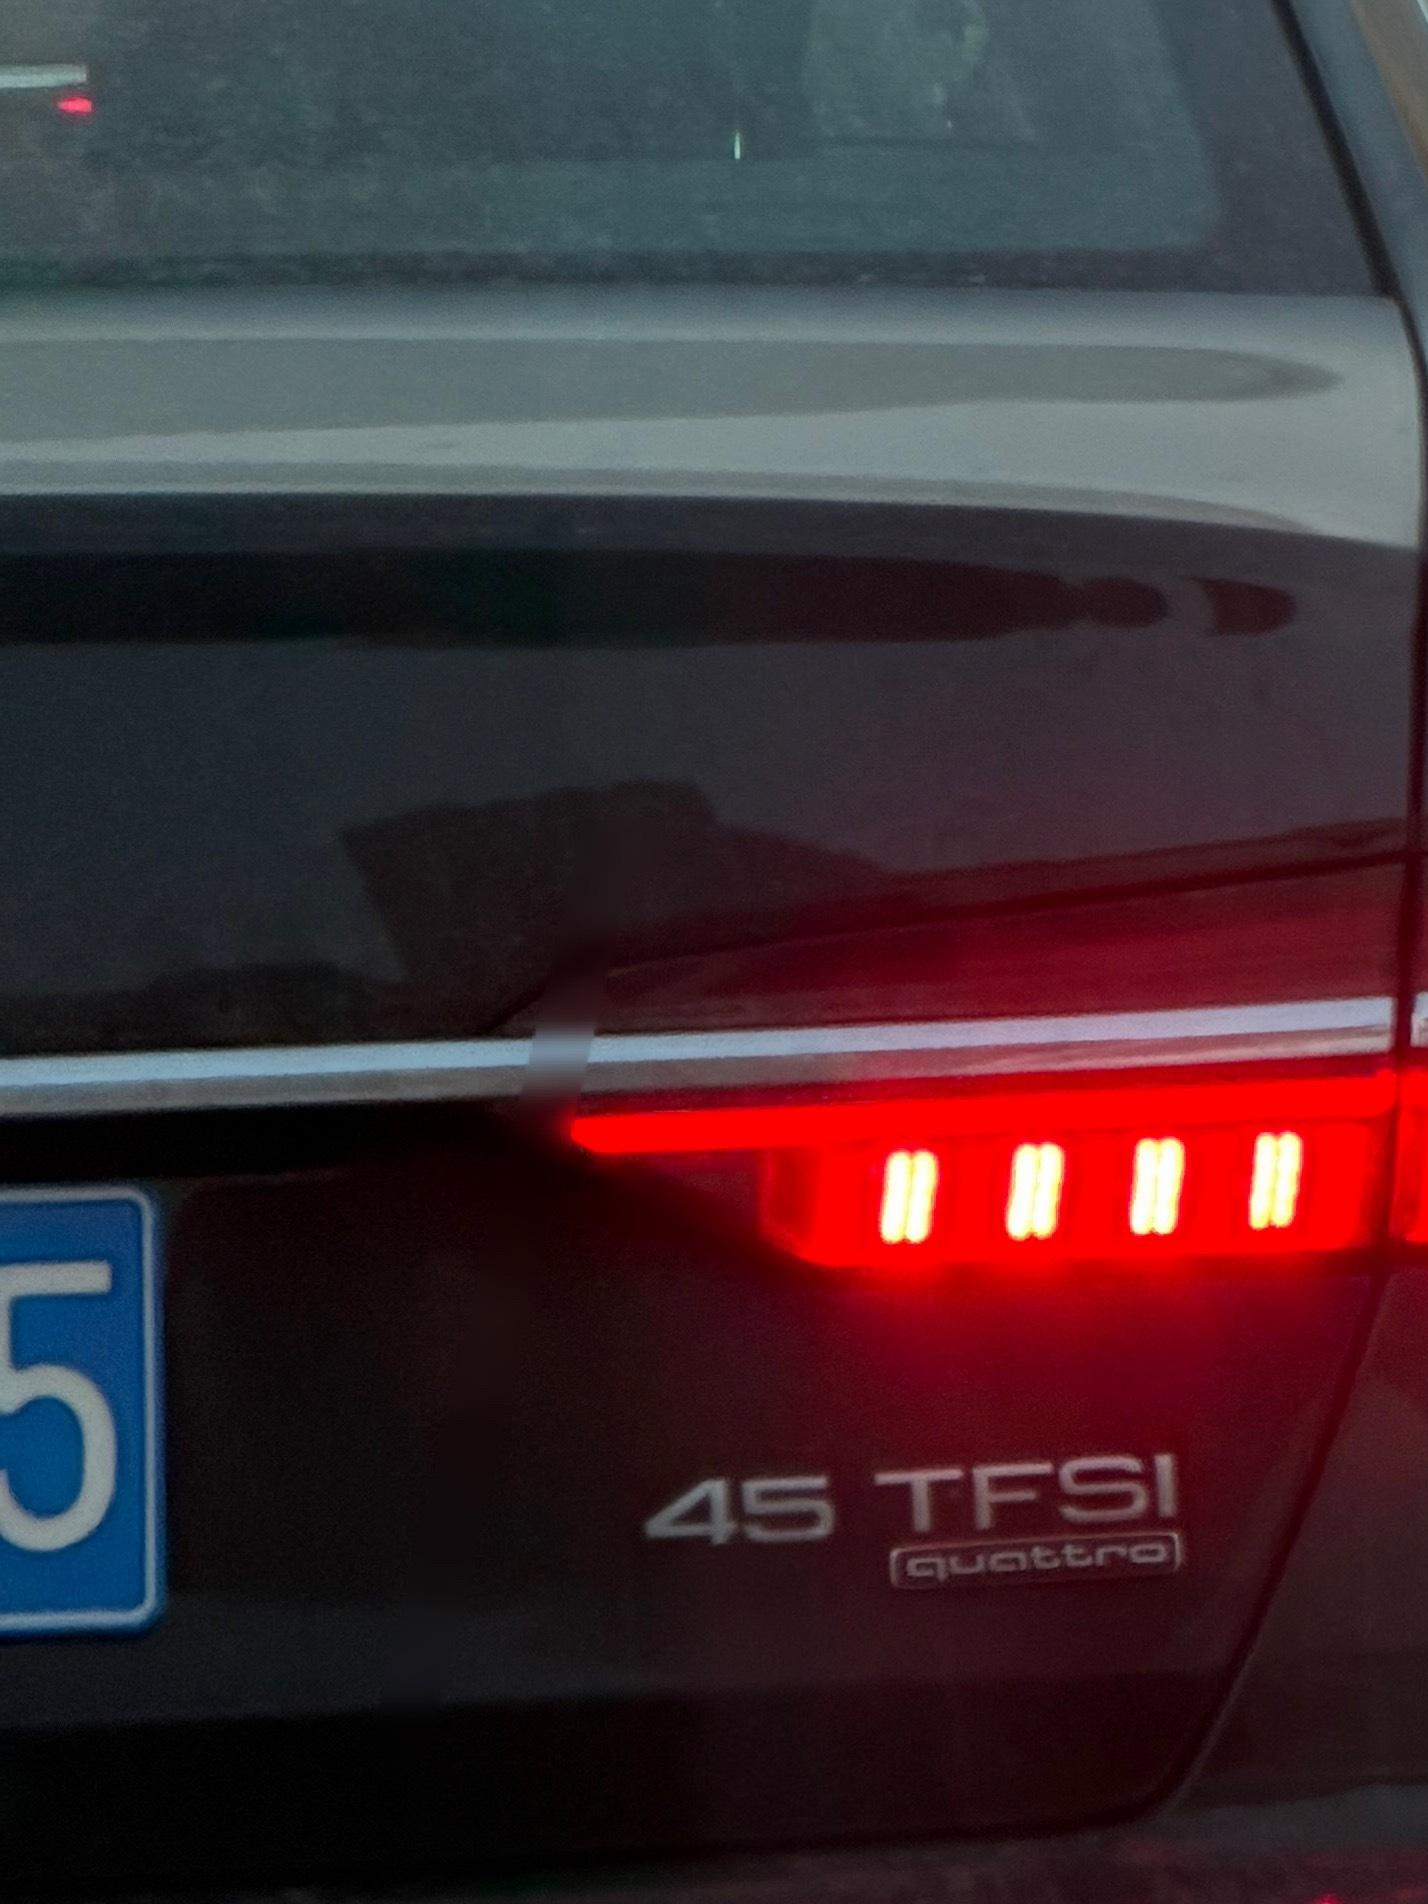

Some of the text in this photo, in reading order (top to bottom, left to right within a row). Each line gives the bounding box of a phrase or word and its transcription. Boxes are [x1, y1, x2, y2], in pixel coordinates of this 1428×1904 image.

[0, 1260, 118, 1552] 5
[644, 1453, 1178, 1544] 45 TFSI
[906, 1541, 1168, 1582] quattro
